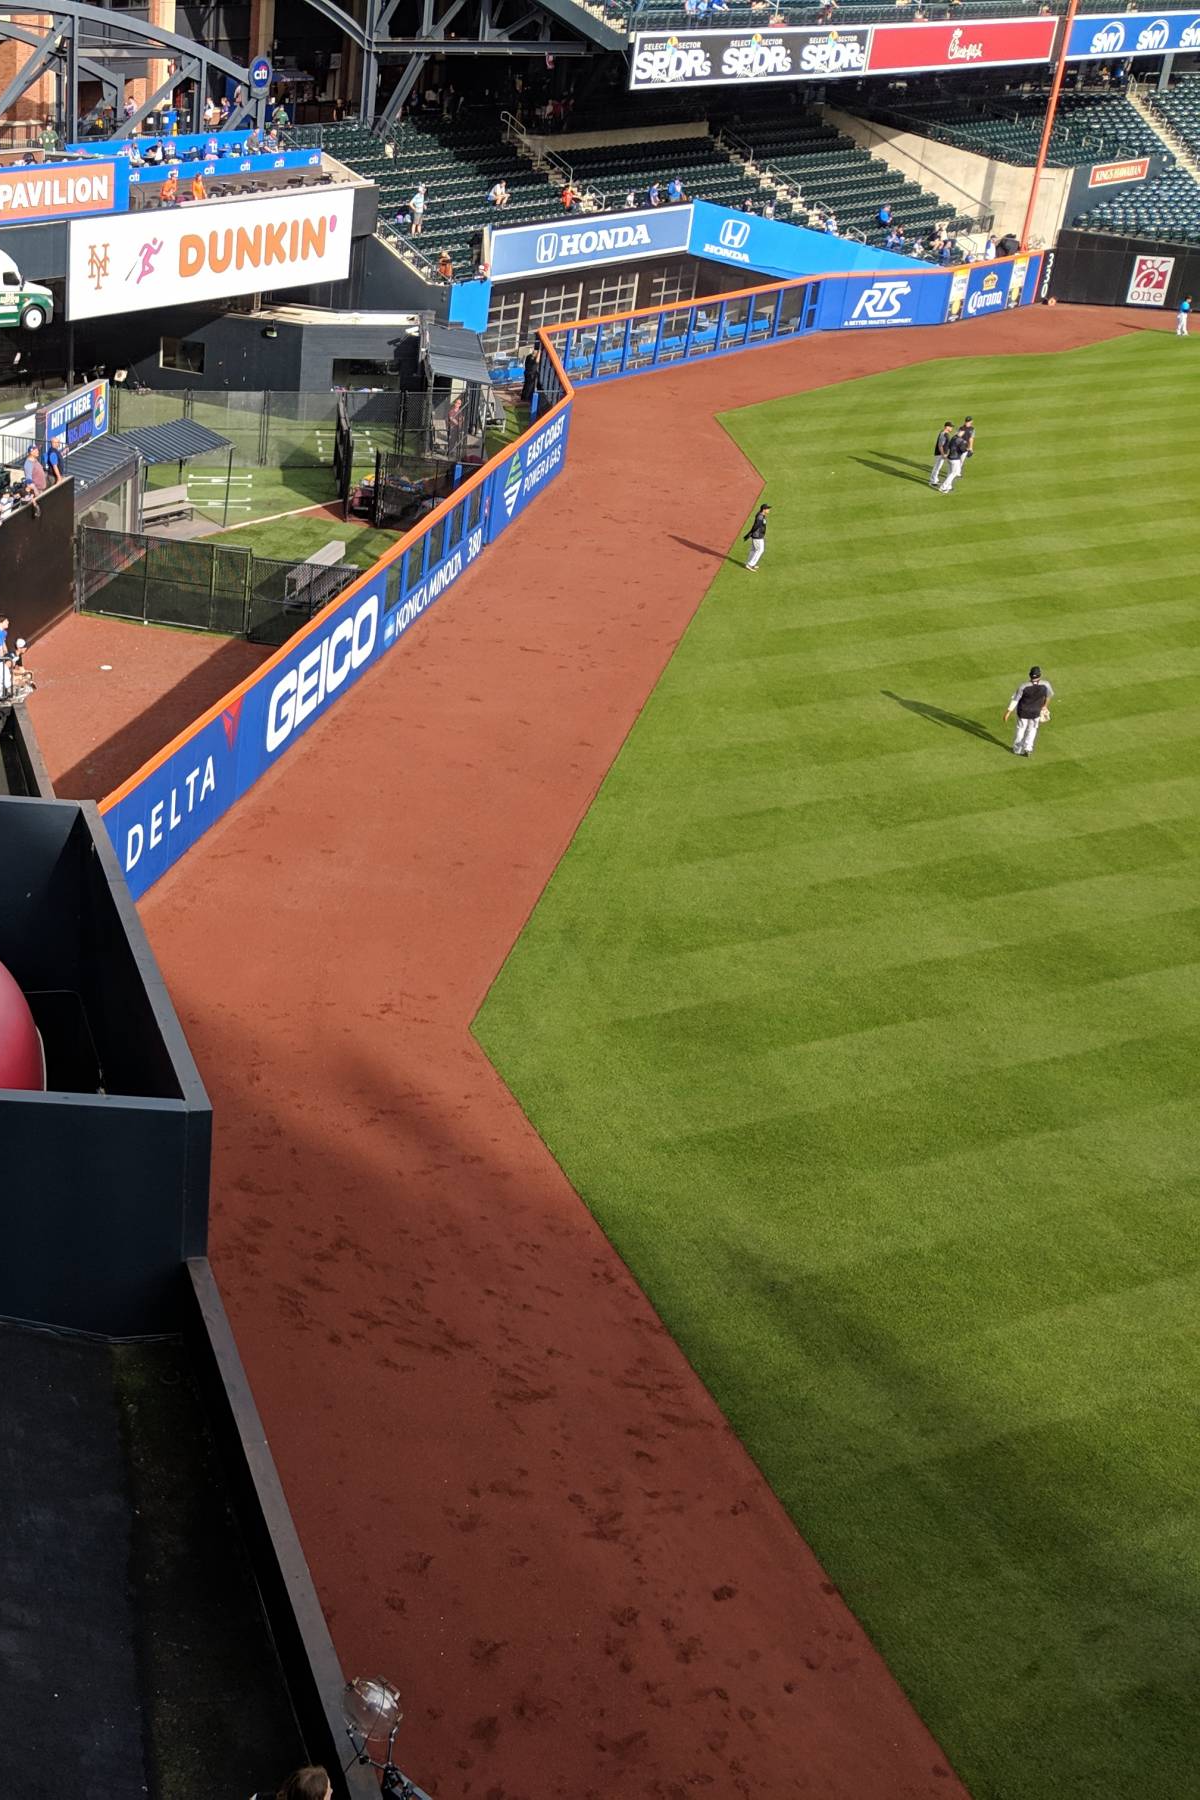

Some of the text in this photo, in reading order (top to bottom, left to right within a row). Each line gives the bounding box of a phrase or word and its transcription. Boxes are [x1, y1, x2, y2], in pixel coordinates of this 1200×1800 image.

[643, 41, 702, 51] SELECT SECTOR
[730, 38, 783, 47] SELECT SECTOR
[809, 35, 858, 44] SELECT SECTOR
[179, 214, 338, 278] DUNKIN'
[559, 224, 651, 257] HONDA
[703, 243, 750, 263] HONDA
[851, 281, 912, 319] RTS
[967, 290, 1003, 314] Corona
[1130, 290, 1163, 302] one
[51, 393, 91, 430] HIT IT HERE
[526, 414, 566, 466] EAST COAST
[522, 466, 546, 497] POWER
[550, 443, 562, 469] GAS
[467, 528, 483, 563] 380
[395, 550, 463, 637] KONICA MINOLTA
[266, 594, 379, 753] GEICO
[125, 755, 216, 873] DELTA
